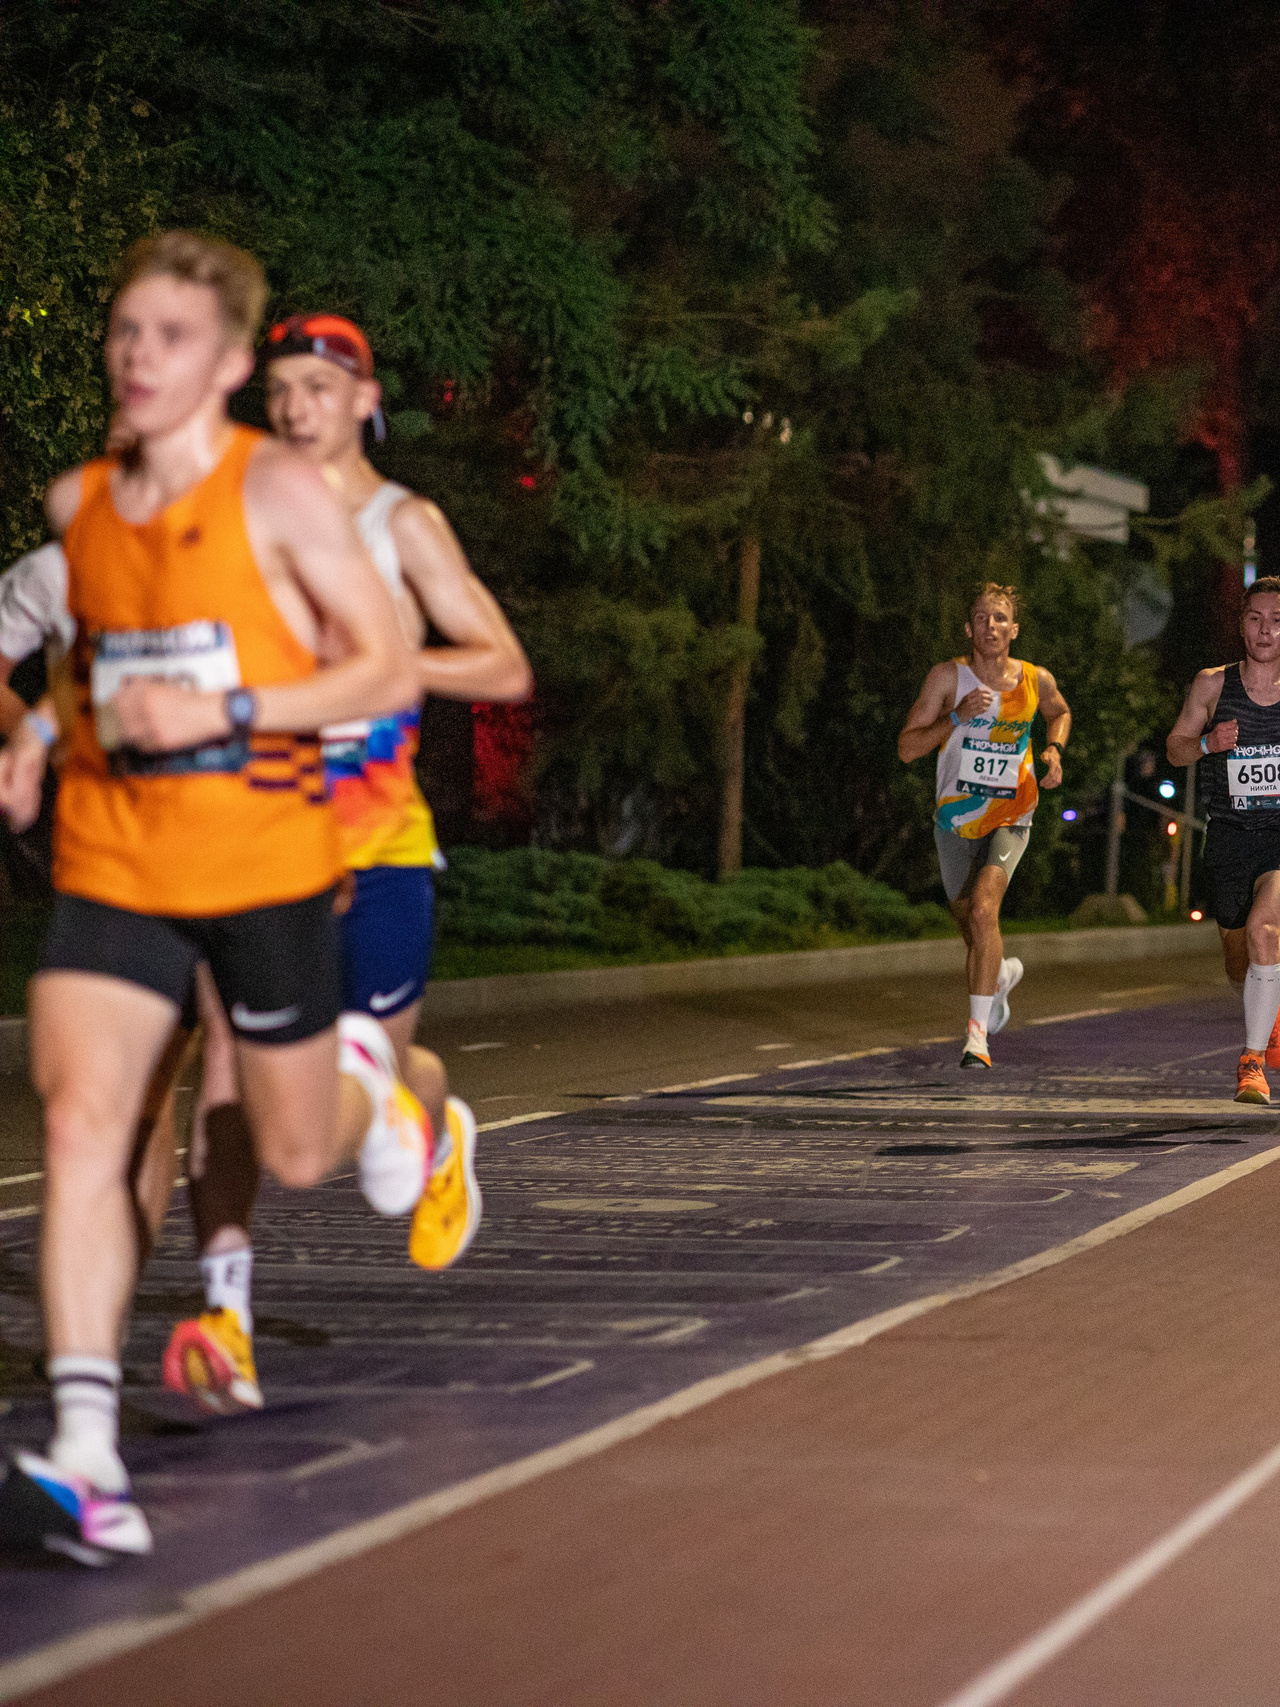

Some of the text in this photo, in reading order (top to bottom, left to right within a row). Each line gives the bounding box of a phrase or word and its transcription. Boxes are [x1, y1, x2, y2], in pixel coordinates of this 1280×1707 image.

[973, 757, 1008, 776] 817
[961, 783, 970, 793] A
[1237, 798, 1245, 808] A
